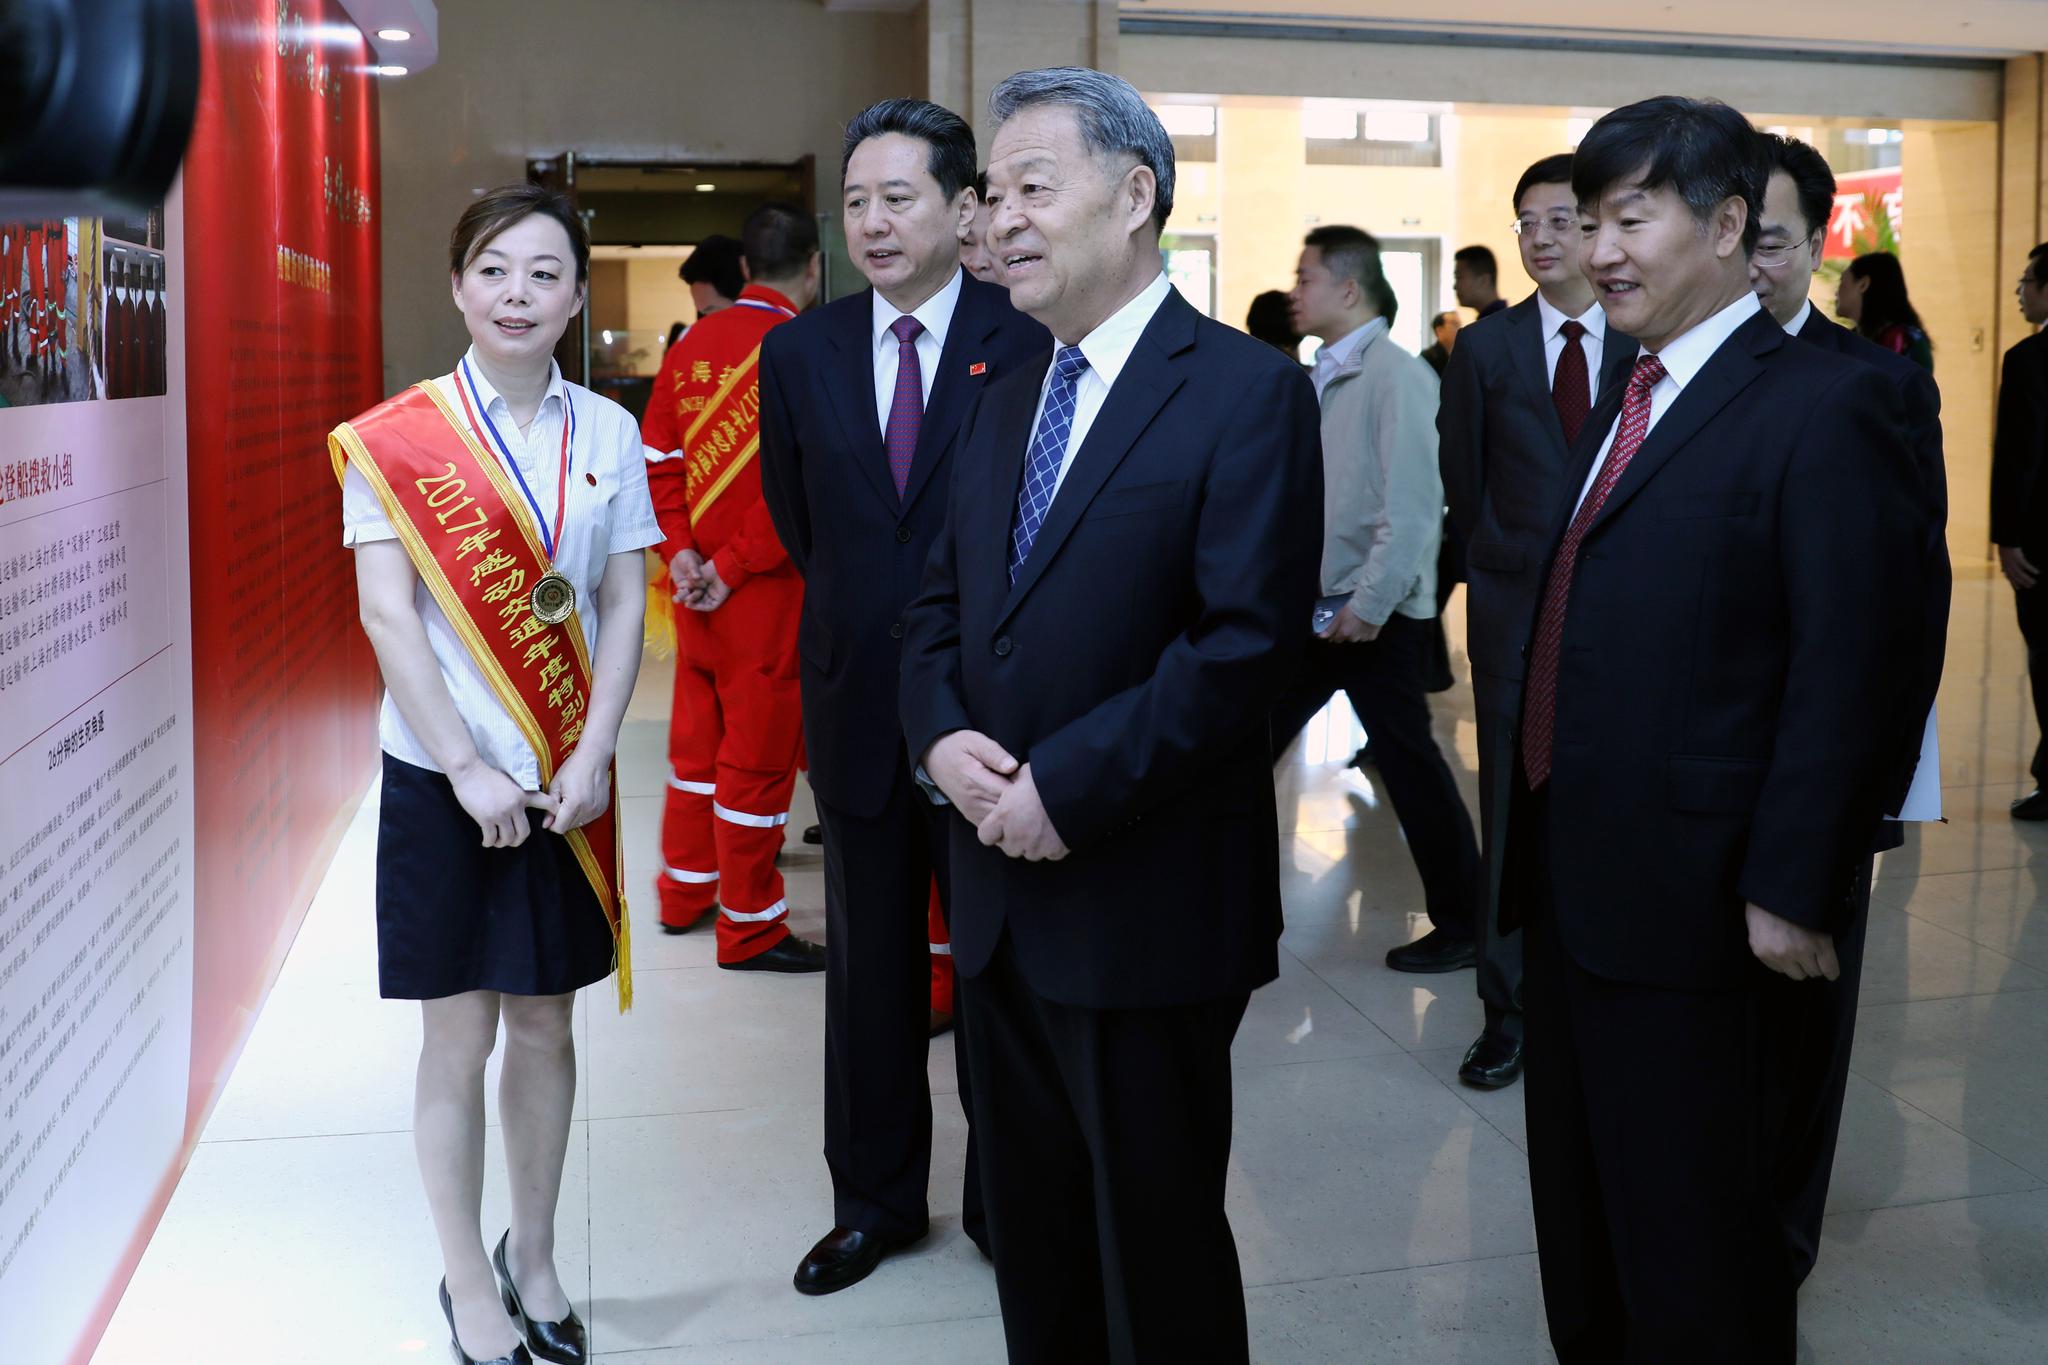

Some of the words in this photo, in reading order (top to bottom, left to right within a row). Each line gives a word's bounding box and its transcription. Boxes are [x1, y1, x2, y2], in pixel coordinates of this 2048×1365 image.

[0, 454, 73, 505] 登船搜救小组
[415, 462, 585, 760] 2017年感动交通年度特别致
